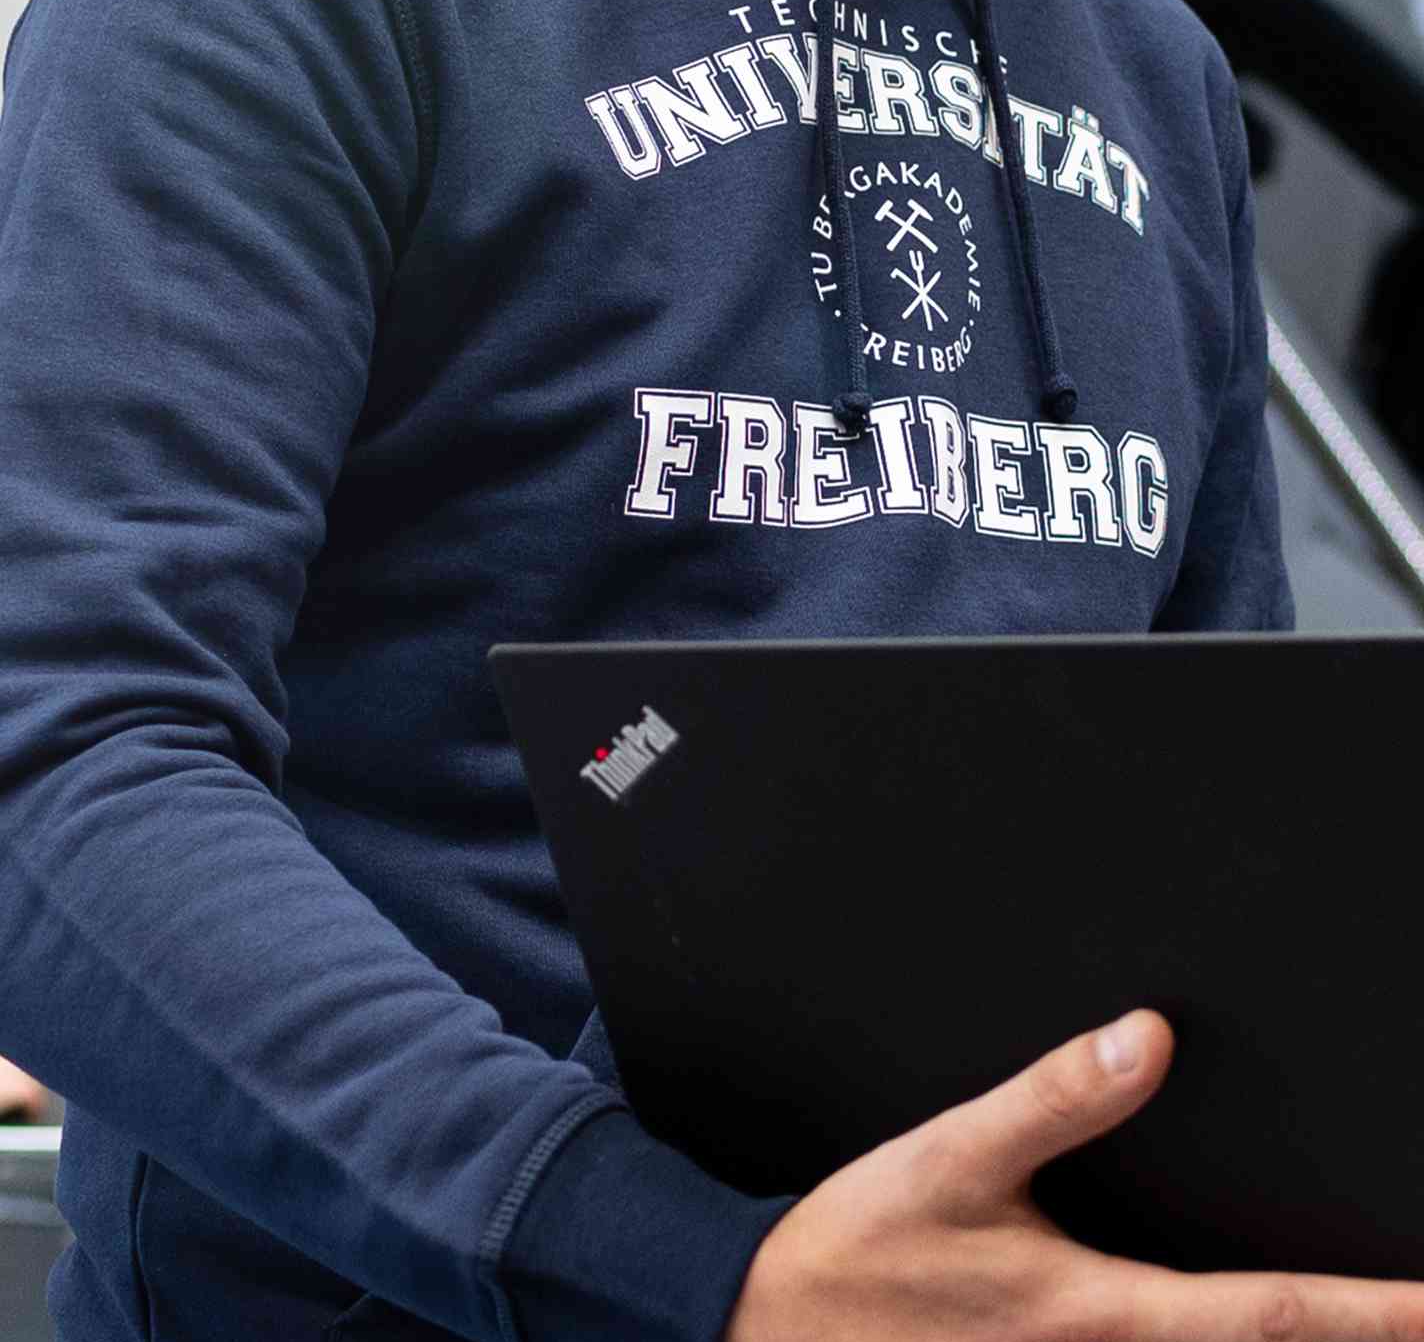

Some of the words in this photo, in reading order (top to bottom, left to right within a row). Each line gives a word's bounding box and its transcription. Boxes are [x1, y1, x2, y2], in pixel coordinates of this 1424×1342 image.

[811, 252, 837, 302] TU
[813, 162, 981, 311] BGAKADEMIE
[860, 323, 972, 372] REIBERG
[624, 387, 1168, 558] FREIBERG
